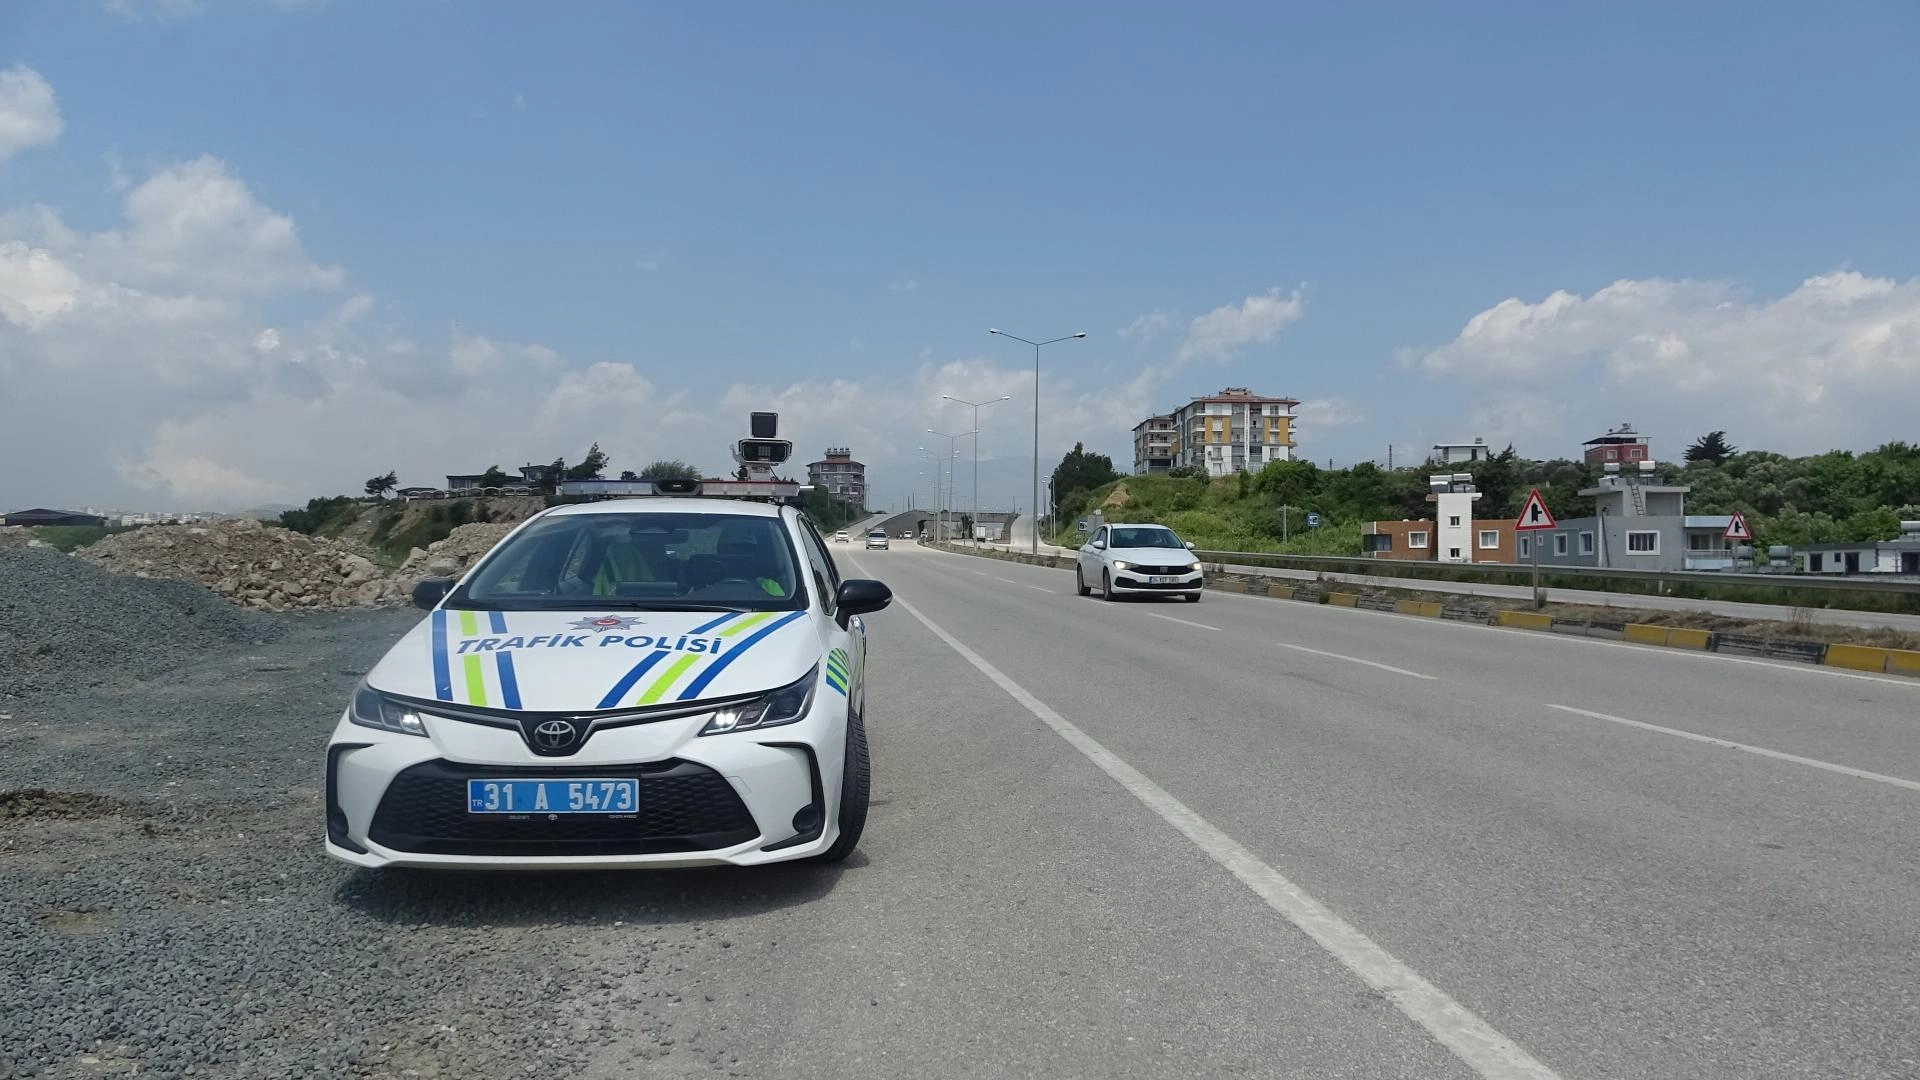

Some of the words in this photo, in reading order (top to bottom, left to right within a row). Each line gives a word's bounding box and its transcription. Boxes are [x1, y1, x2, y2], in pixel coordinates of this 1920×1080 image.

[456, 633, 593, 654] TRAFİK
[600, 634, 723, 654] POLİSİ
[471, 799, 483, 807] TR
[484, 783, 513, 810] 31
[534, 783, 549, 810] A
[568, 783, 632, 810] 5473
